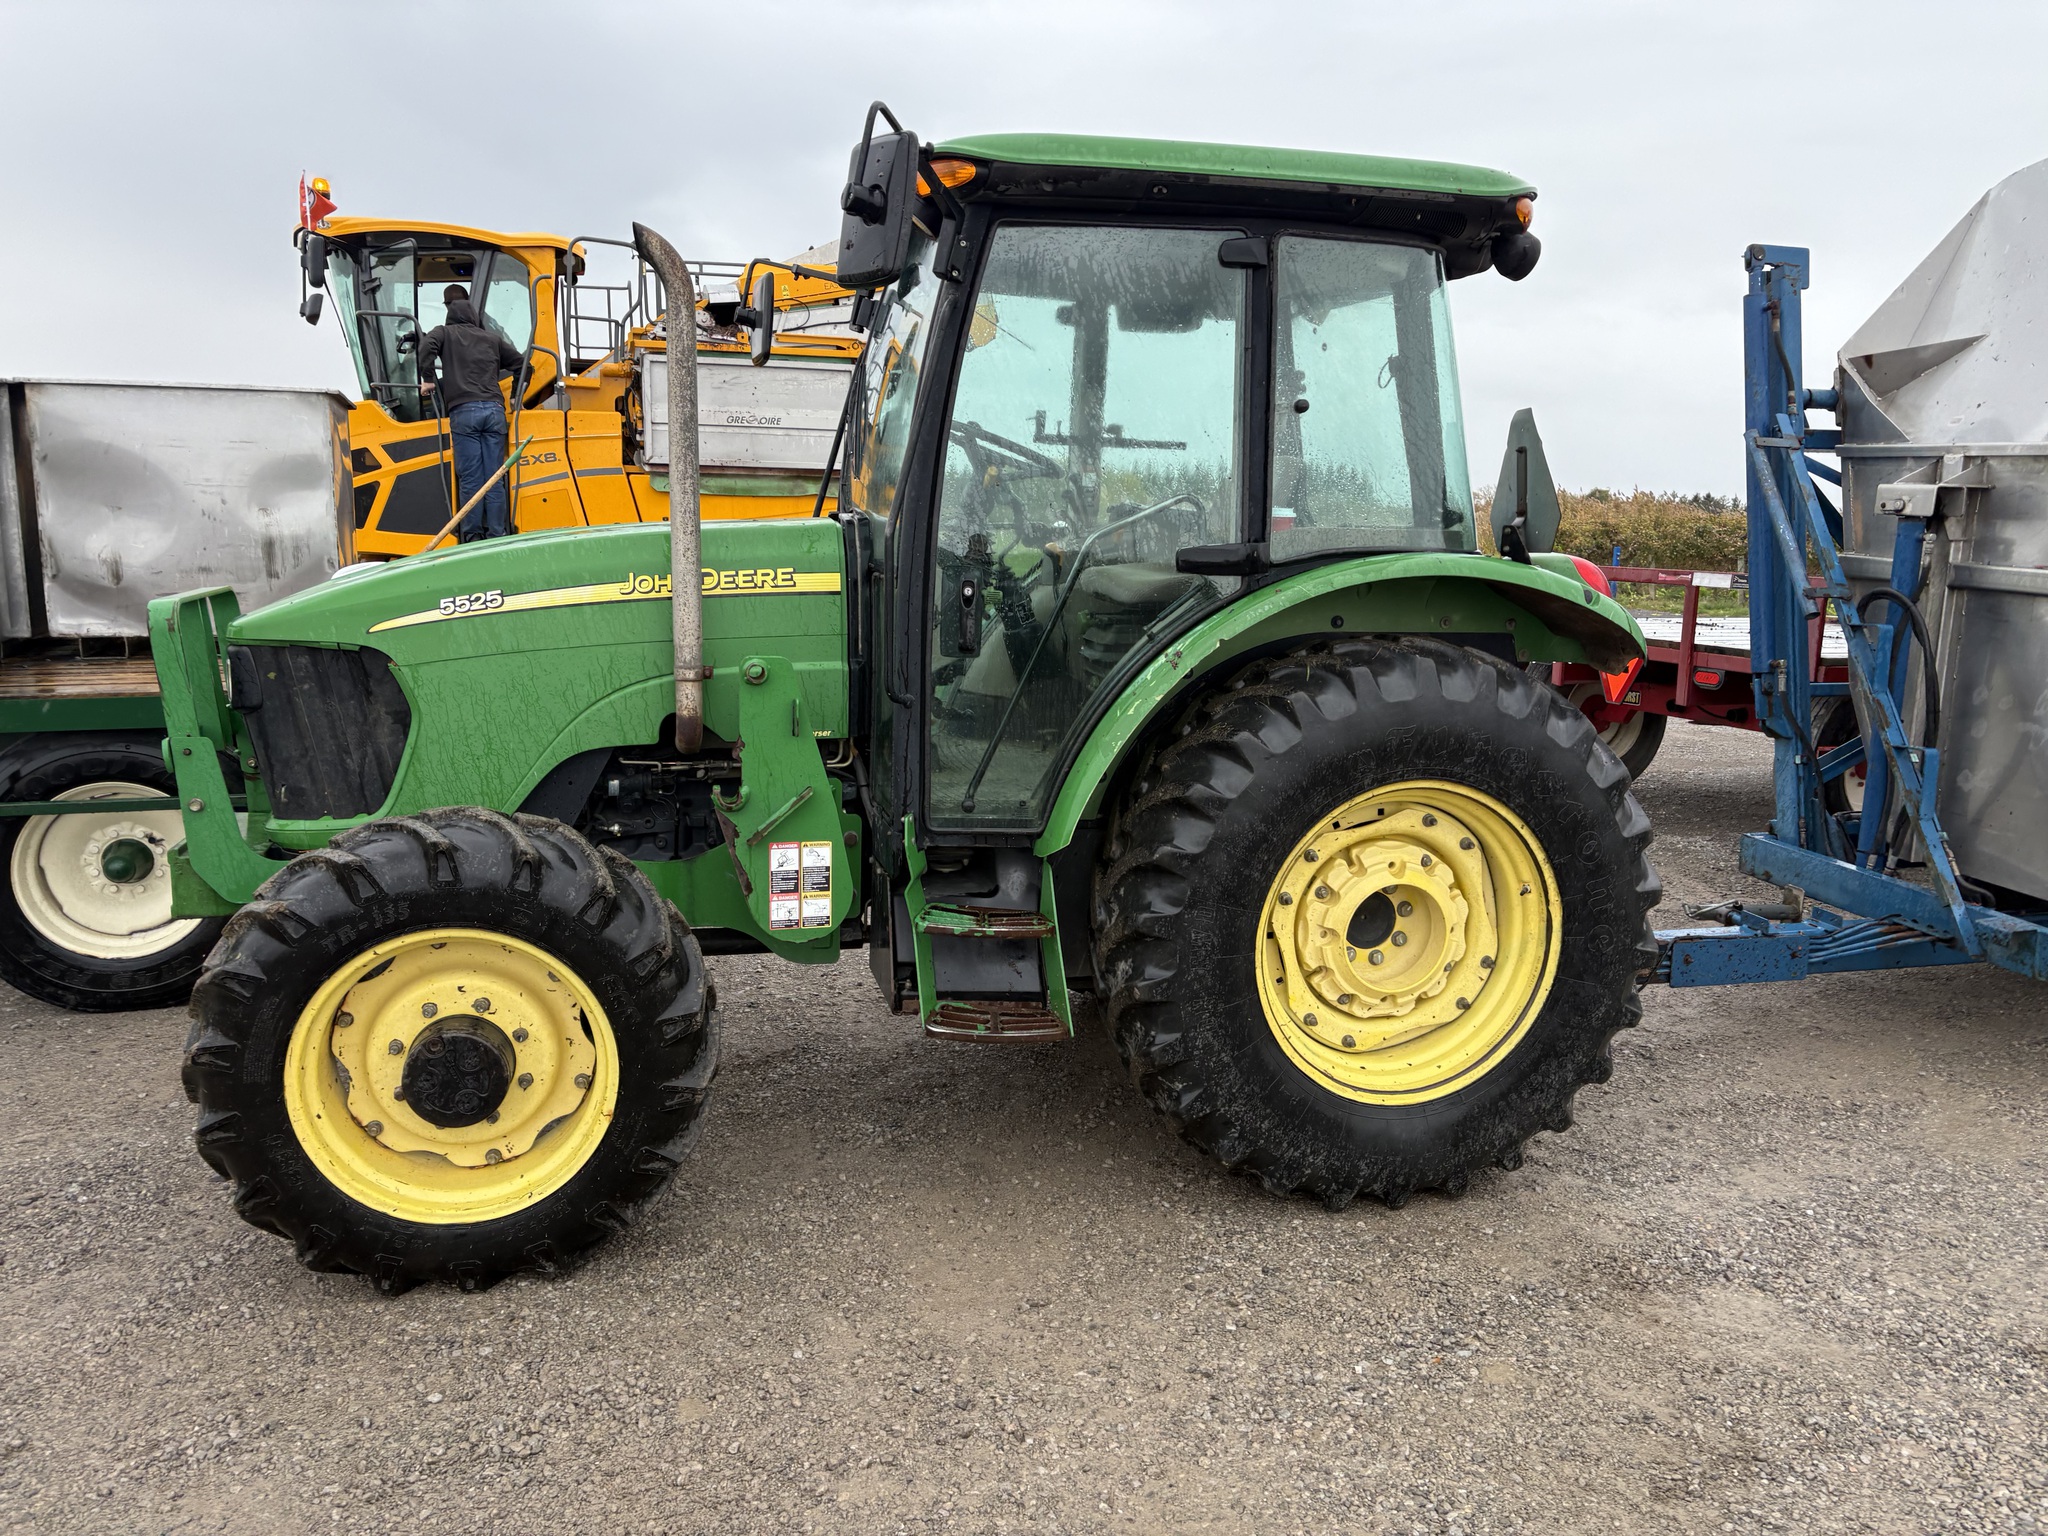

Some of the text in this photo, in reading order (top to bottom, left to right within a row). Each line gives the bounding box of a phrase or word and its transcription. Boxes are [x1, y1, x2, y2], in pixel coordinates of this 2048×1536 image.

[519, 452, 558, 466] GX8
[619, 567, 796, 594] JOH DEERE
[439, 589, 504, 616] 5525
